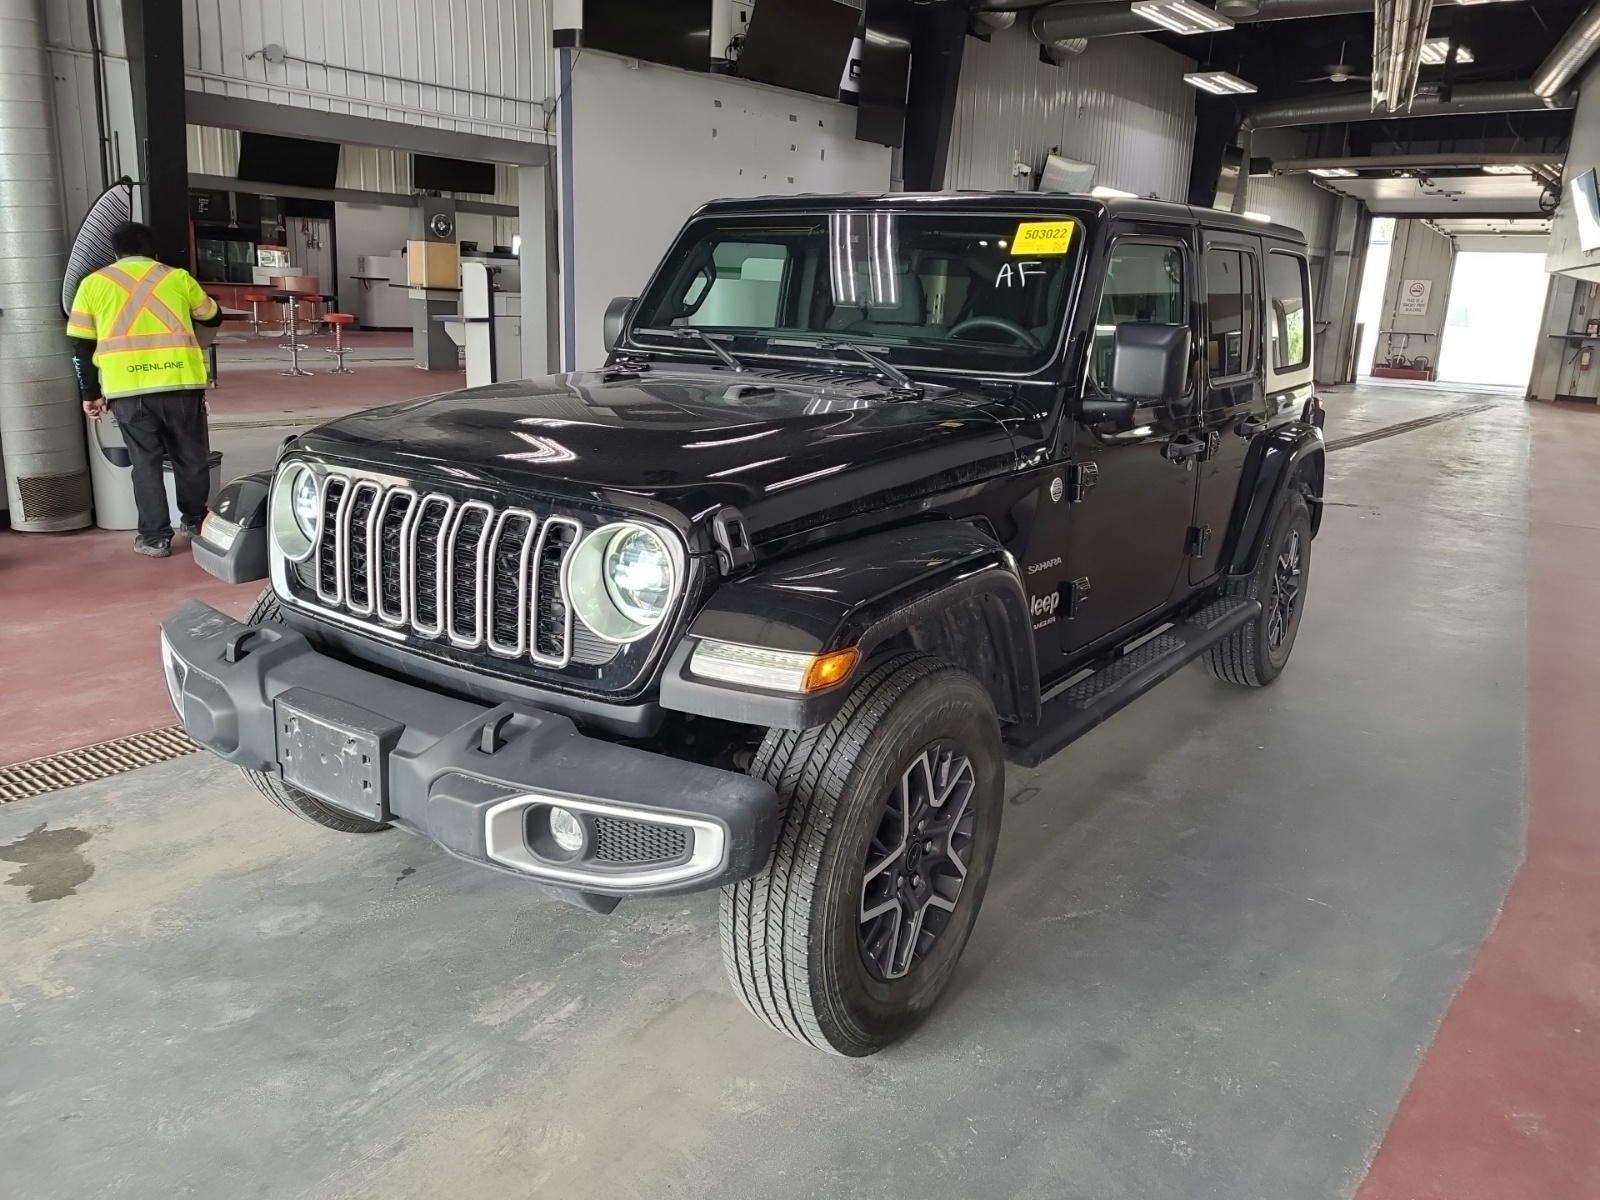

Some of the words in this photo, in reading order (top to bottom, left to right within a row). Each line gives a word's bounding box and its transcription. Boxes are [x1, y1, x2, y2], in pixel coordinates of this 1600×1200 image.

[1024, 228, 1068, 240] 503022
[995, 261, 1047, 288] AF
[126, 361, 185, 373] OPENLANE
[1028, 556, 1062, 574] SAHARA
